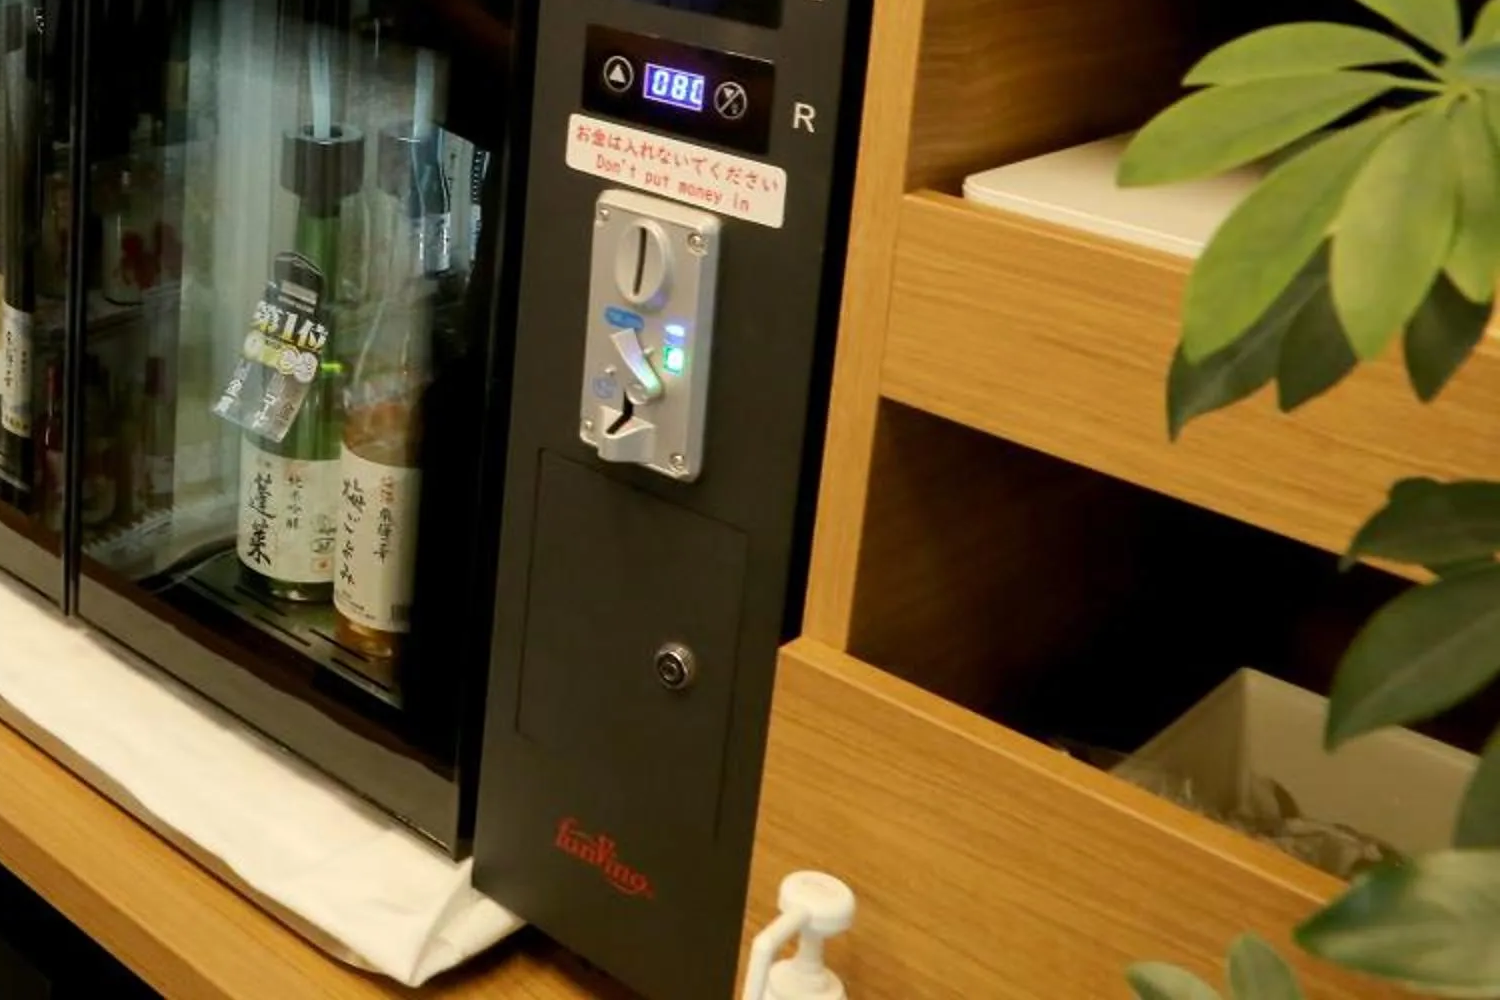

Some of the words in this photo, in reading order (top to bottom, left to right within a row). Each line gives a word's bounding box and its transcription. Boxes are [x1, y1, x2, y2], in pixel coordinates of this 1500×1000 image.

[793, 102, 818, 133] R
[576, 125, 780, 193] お金は入れないでください
[595, 154, 637, 180] Don't
[644, 171, 670, 190] put
[678, 180, 723, 206] money
[732, 191, 750, 213] in
